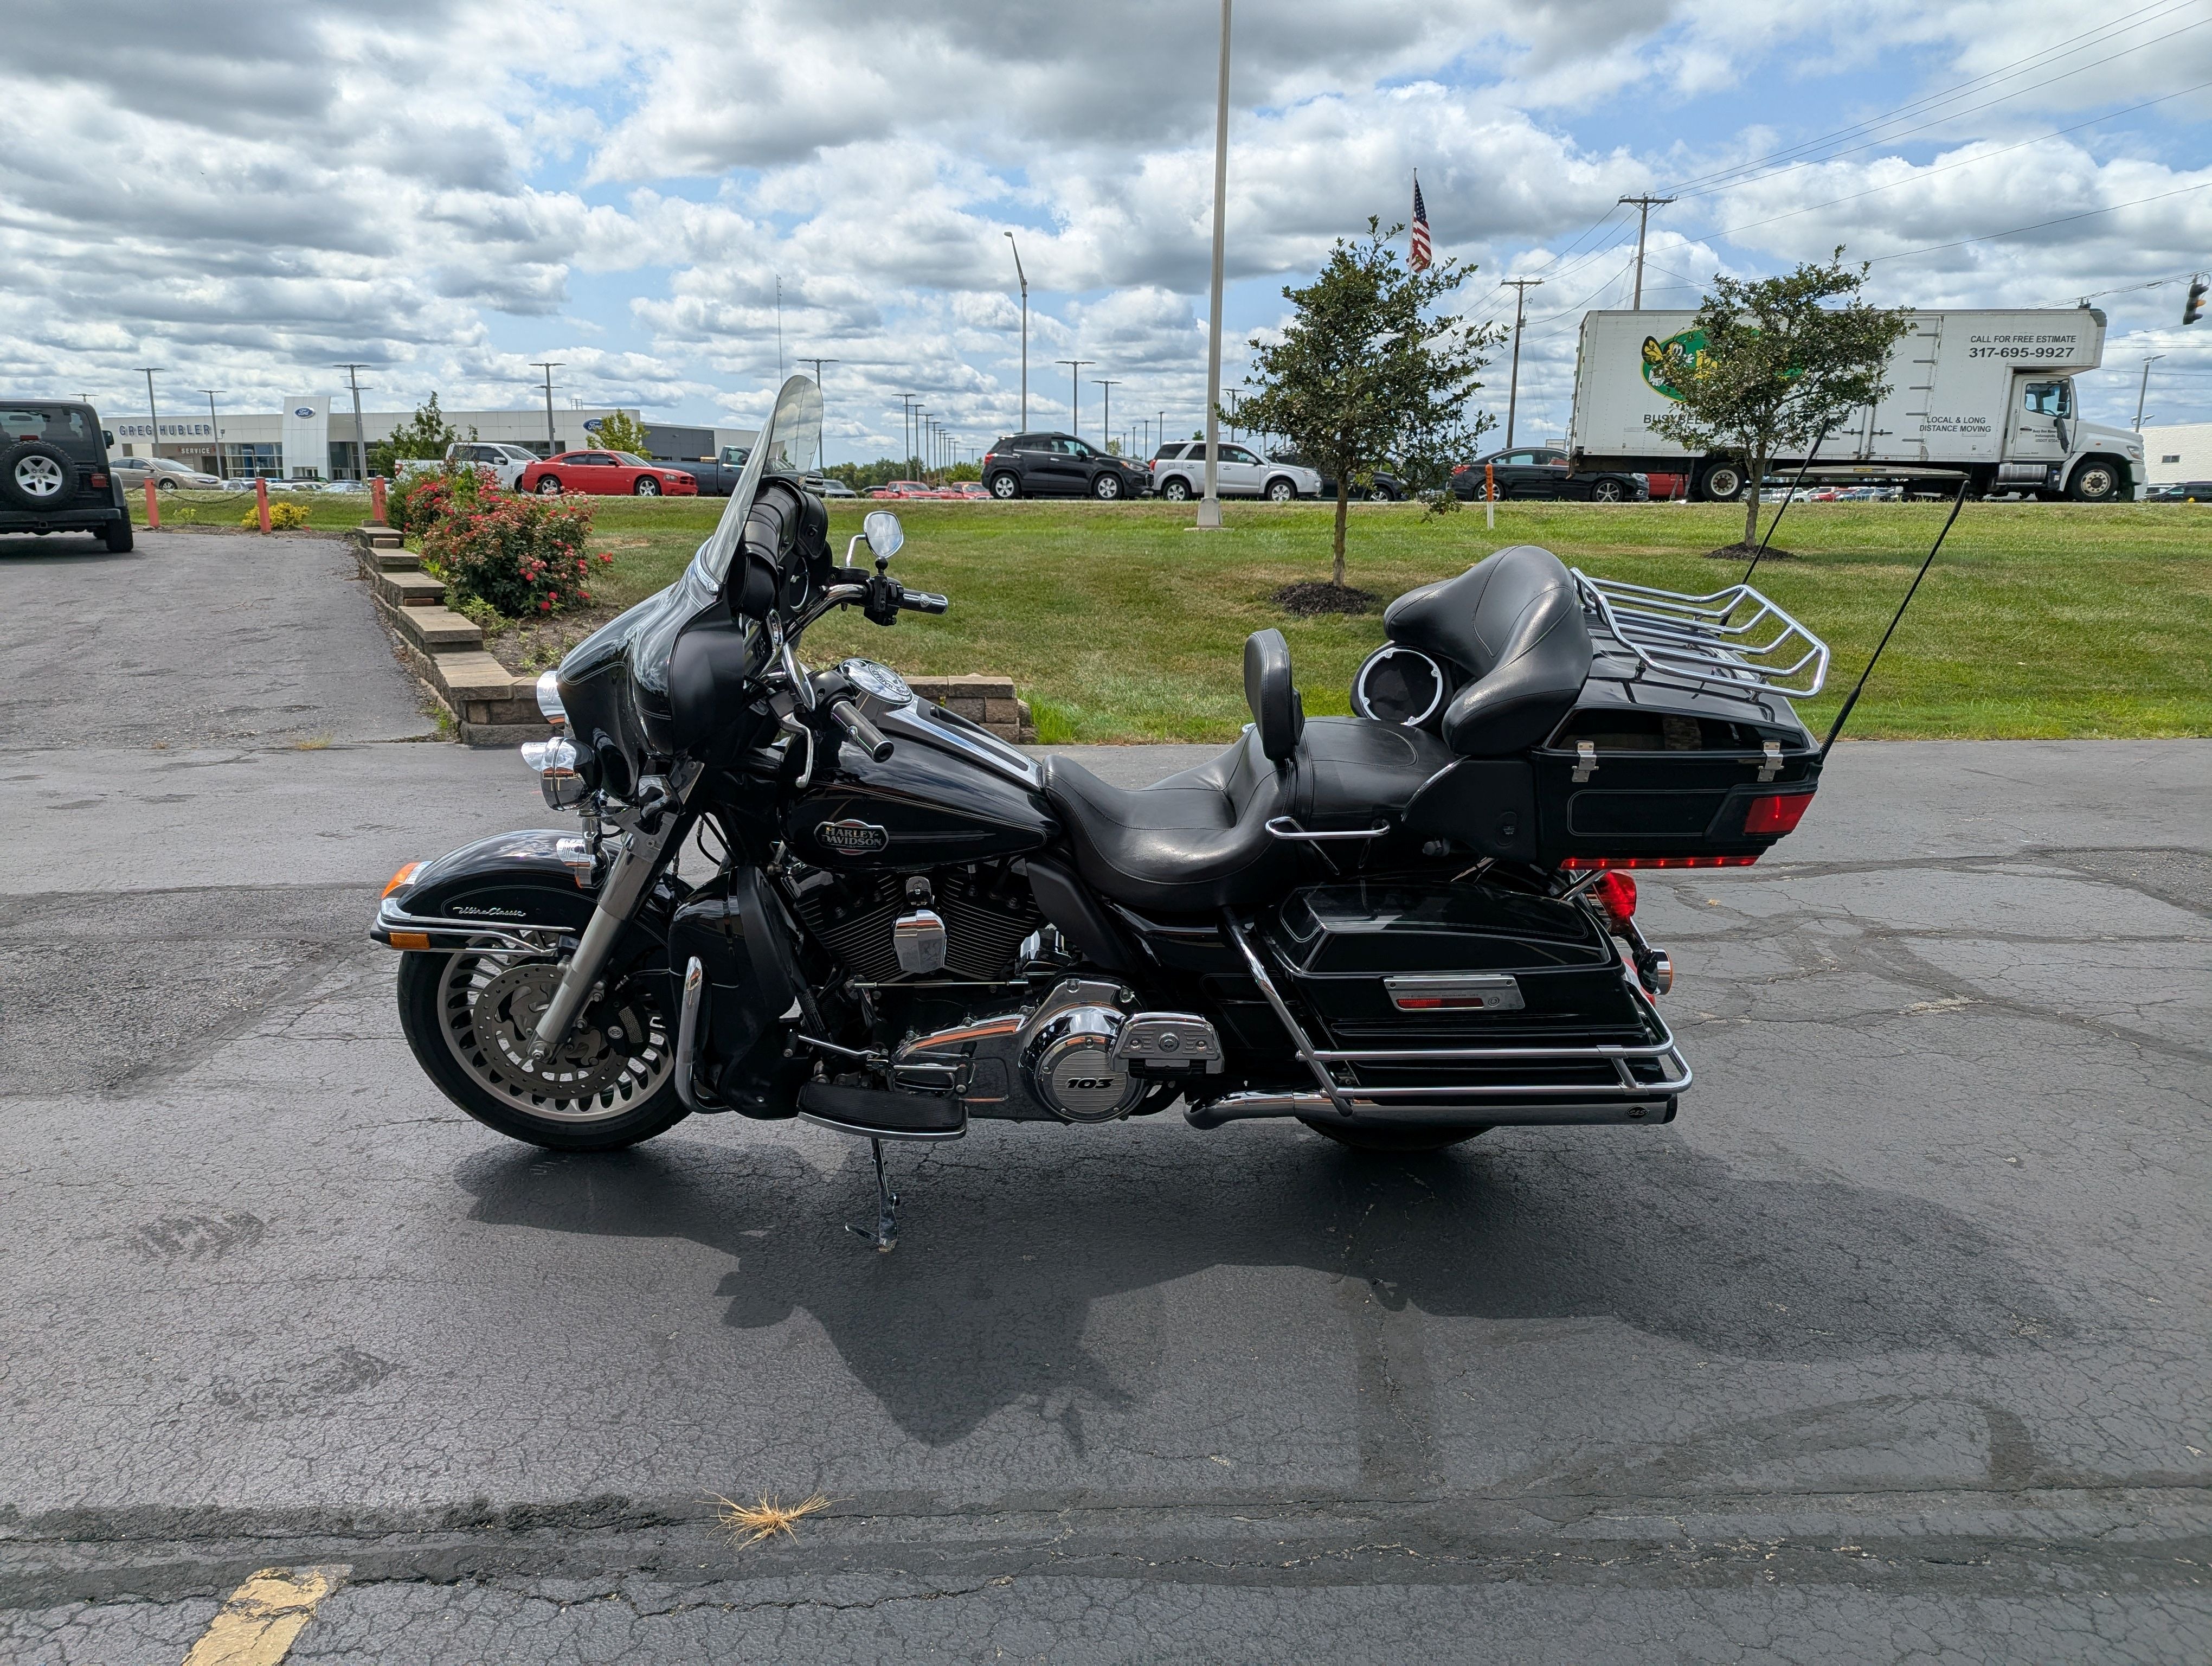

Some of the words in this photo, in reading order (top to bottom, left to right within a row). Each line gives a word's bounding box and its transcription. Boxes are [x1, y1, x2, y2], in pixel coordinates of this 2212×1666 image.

[1969, 347, 2075, 358] 317-695-9927
[119, 425, 153, 436] GREG
[159, 424, 210, 436] HUBLER
[825, 827, 879, 838] HARLEY-
[821, 835, 882, 846] DAVIDSON
[1065, 1077, 1116, 1090] 103
